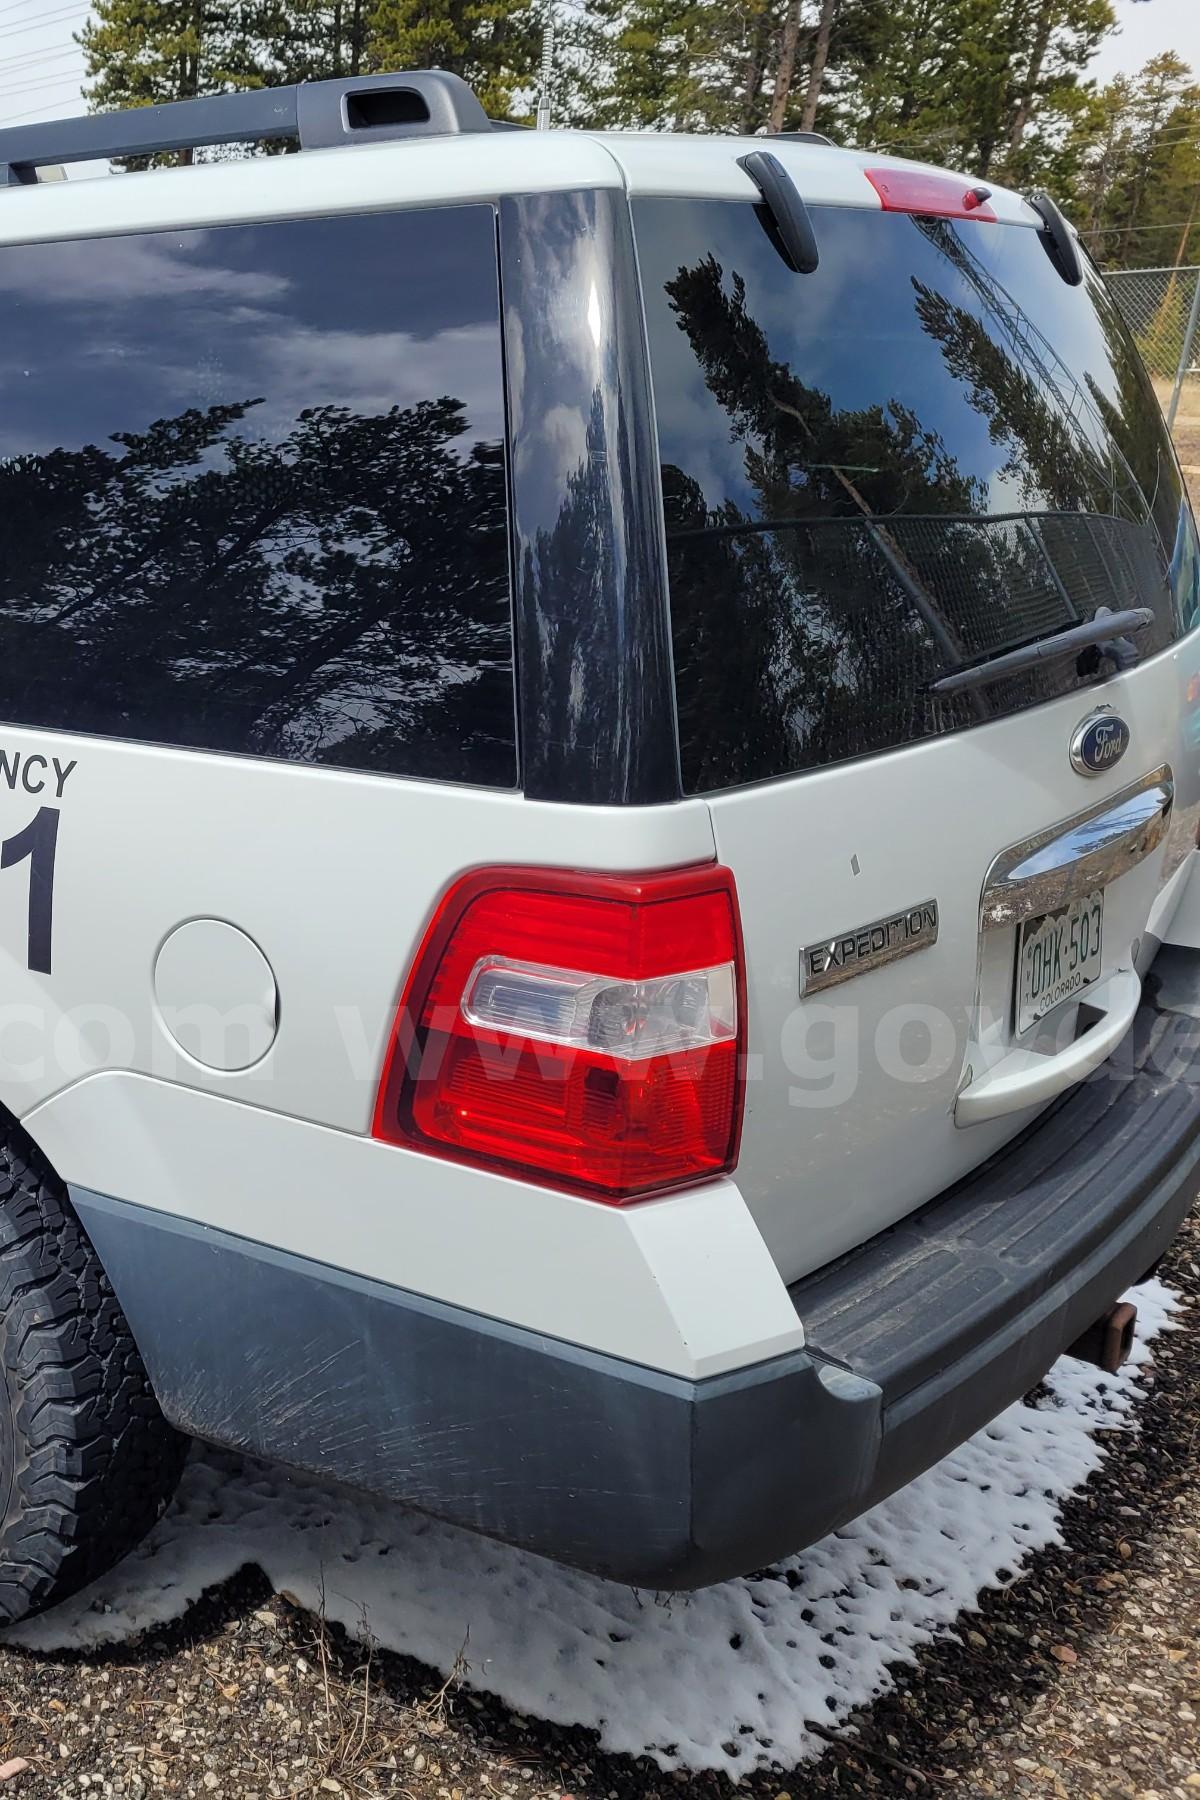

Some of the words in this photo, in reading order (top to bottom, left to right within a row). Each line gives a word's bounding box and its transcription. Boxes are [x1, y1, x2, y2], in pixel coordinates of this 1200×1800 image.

[1094, 723, 1122, 763] Ford
[808, 906, 938, 976] EXPEDITION
[1039, 972, 1081, 1012] COLORADO
